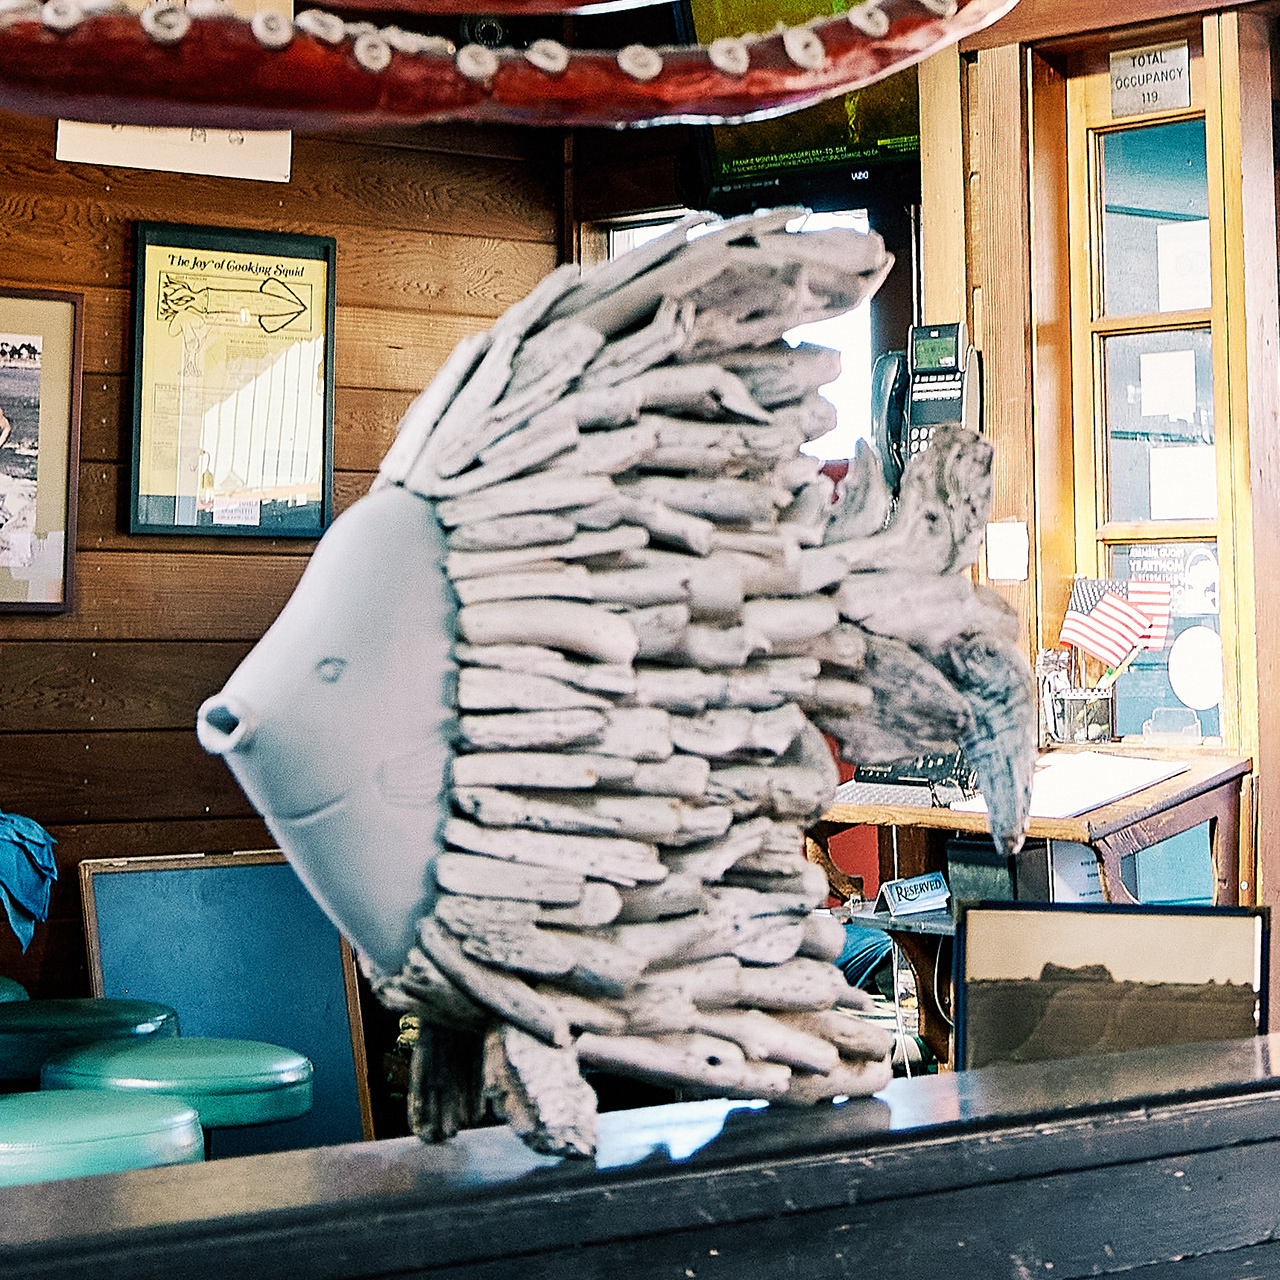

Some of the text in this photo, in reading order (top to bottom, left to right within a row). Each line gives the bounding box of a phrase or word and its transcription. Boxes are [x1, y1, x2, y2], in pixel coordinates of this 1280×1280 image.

[1130, 50, 1167, 68] TOTAL
[1115, 68, 1183, 90] OCCUPANCY
[1142, 91, 1158, 104] 119
[168, 253, 306, 279] The Joy of Cooking Squid
[895, 878, 943, 903] RESERVED
